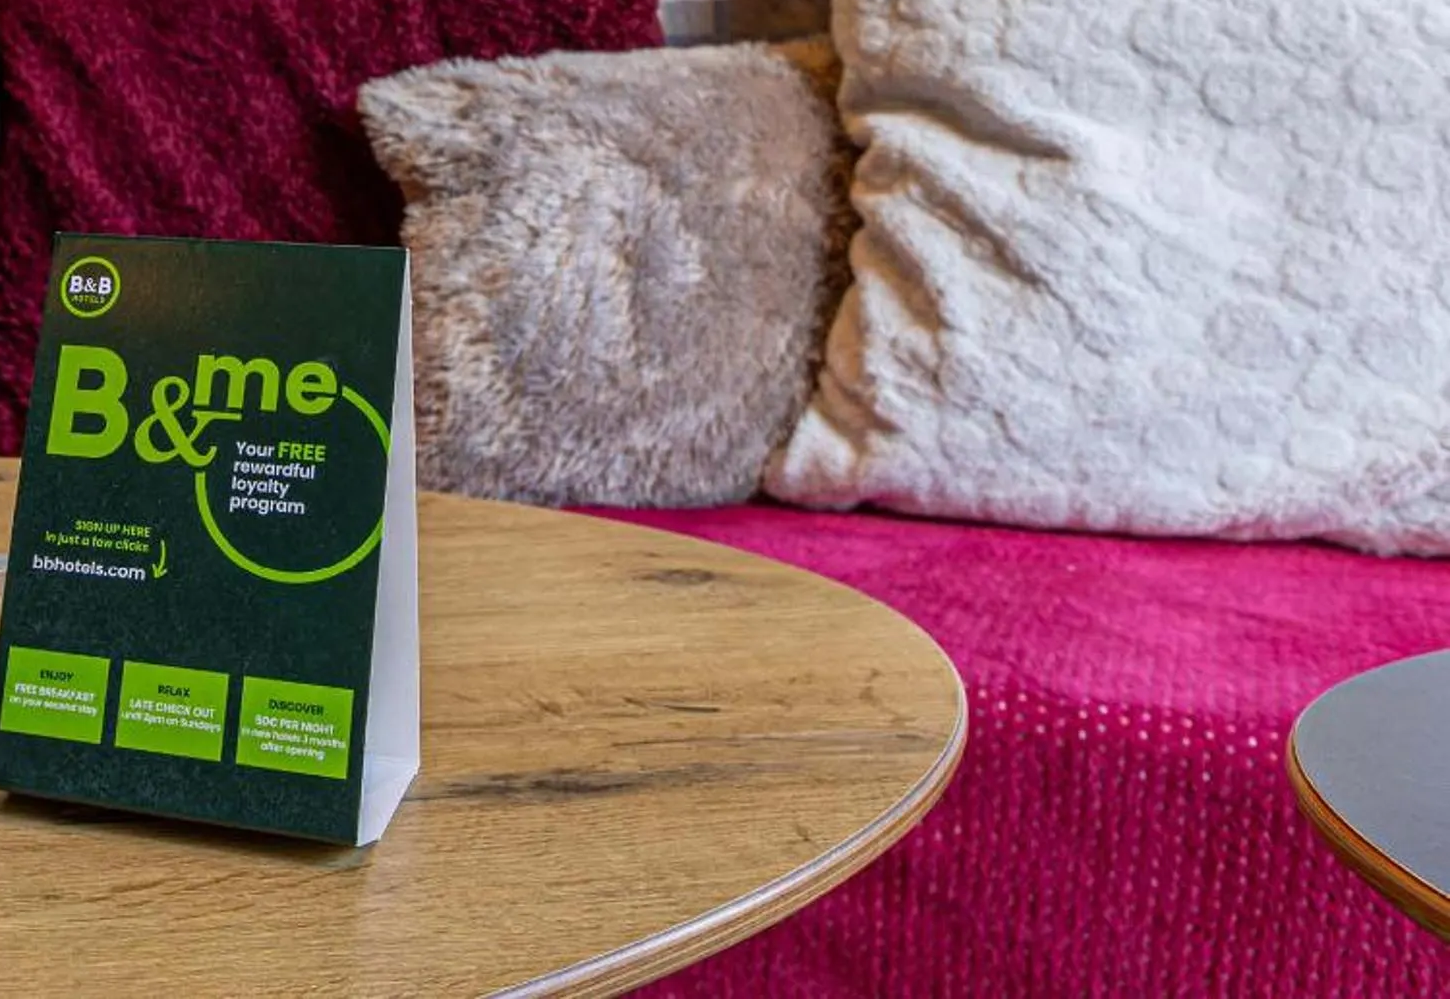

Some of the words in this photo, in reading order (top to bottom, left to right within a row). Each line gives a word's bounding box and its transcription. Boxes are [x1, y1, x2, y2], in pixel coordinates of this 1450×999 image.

[69, 275, 112, 295] B&B
[236, 441, 275, 457] Your
[277, 441, 327, 462] FREE
[233, 461, 316, 480] rewardful
[231, 475, 290, 499] loyalty
[229, 495, 305, 515] program
[75, 520, 104, 532] SIGN
[105, 523, 120, 534] UP
[123, 525, 152, 538] HERE
[57, 532, 80, 546] just
[81, 537, 90, 546] a
[92, 536, 113, 549] few
[115, 539, 150, 553] clicks
[32, 554, 147, 581] bbhotels.com
[40, 669, 75, 682] ENJOY
[158, 685, 191, 698] RELAX
[129, 699, 154, 711] LATE
[155, 702, 191, 716] CHECK
[192, 706, 216, 719] OUT
[268, 699, 324, 716] DISCOVER
[279, 719, 300, 731] PER
[301, 722, 335, 736] NIGHT
